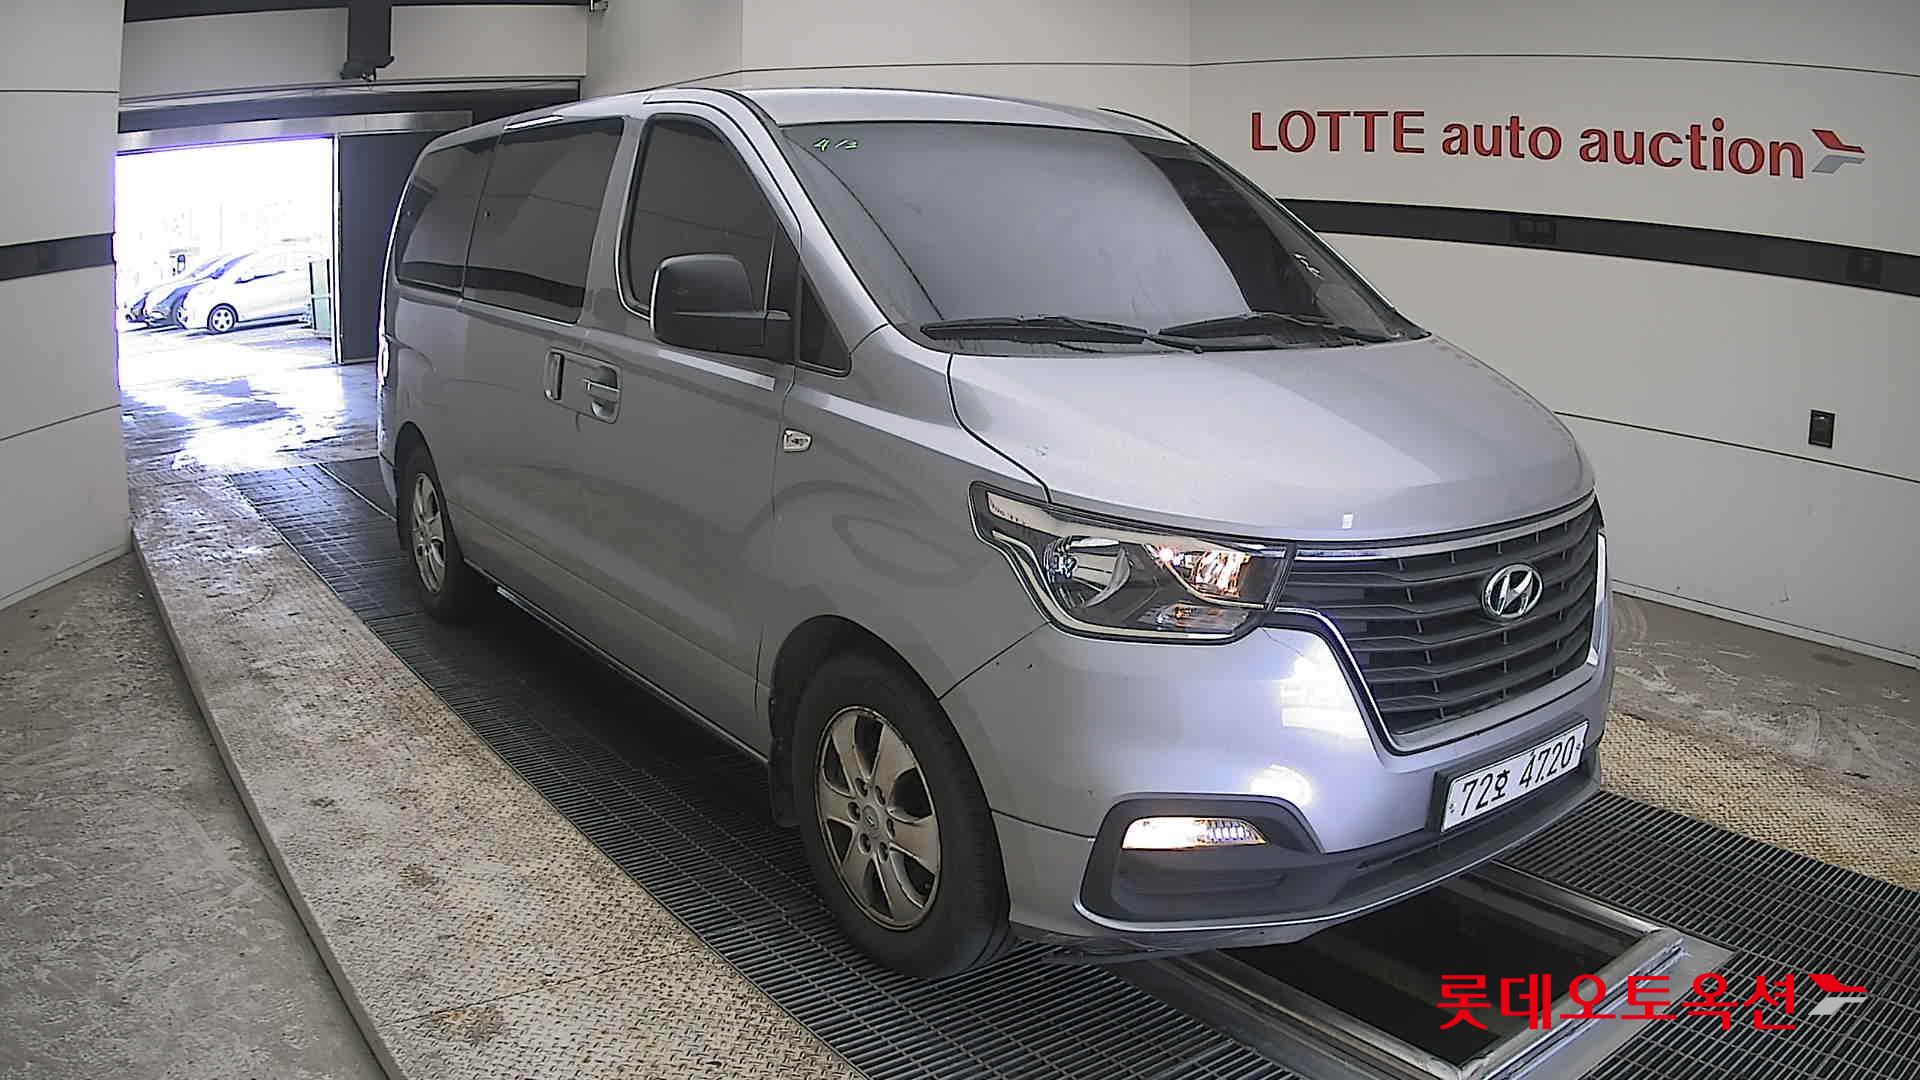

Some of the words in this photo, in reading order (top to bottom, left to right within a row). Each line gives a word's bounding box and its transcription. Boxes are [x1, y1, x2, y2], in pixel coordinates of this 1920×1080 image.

[1251, 111, 1425, 153] LOTTE
[1442, 115, 1561, 160] auto
[1579, 118, 1804, 179] auction
[1461, 769, 1510, 816] 72호
[1519, 735, 1576, 789] 4720
